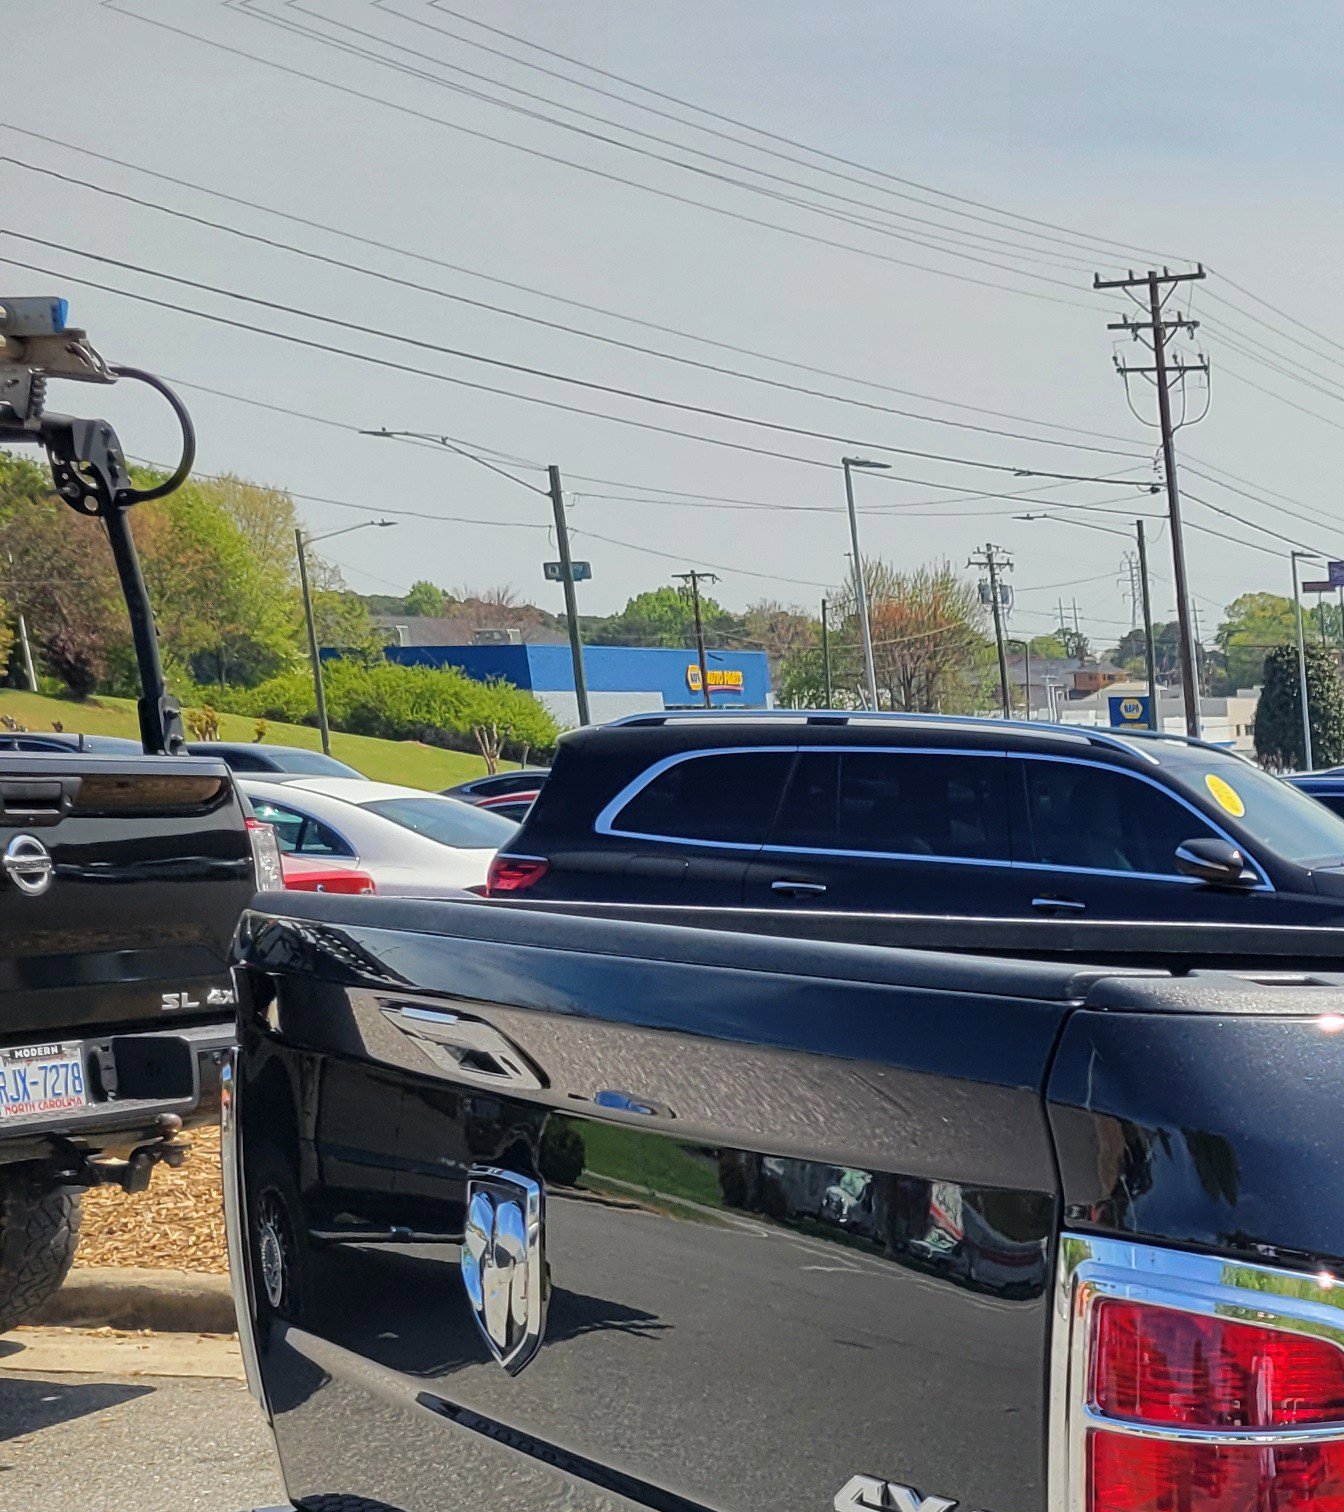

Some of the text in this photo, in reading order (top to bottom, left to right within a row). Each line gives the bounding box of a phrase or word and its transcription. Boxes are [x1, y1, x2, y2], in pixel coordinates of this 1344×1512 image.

[161, 987, 235, 1010] SL 4X
[14, 1045, 59, 1059] MODERN
[0, 1061, 83, 1105] RJX-7278
[5, 1095, 83, 1116] NORTH CAROLINA
